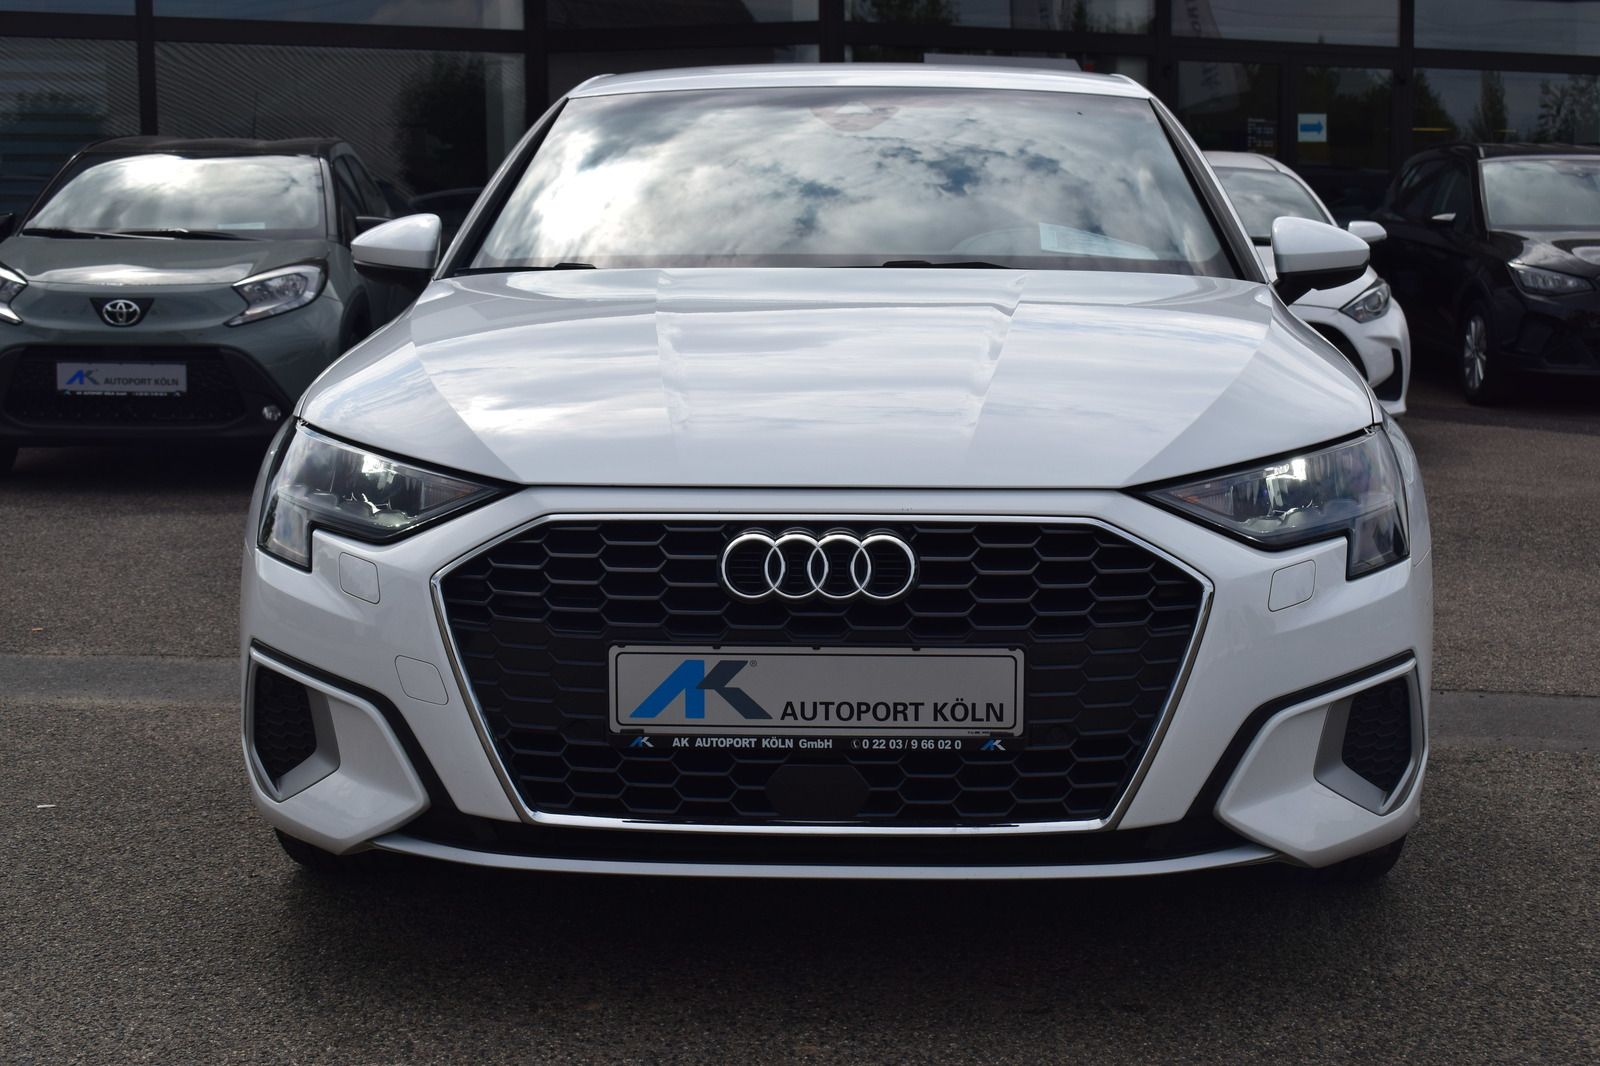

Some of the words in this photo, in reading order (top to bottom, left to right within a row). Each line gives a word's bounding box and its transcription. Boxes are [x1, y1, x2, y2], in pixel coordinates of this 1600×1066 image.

[103, 377, 152, 386] AUTOPORT
[154, 376, 179, 386] KÖLN
[629, 659, 773, 720] AK
[779, 701, 925, 722] AUTOPORT
[933, 697, 1004, 723] KÖLN
[672, 737, 690, 748] AK
[695, 737, 757, 749] AUTOPORT
[762, 735, 794, 749] KÖLN
[799, 738, 833, 749] GmbH
